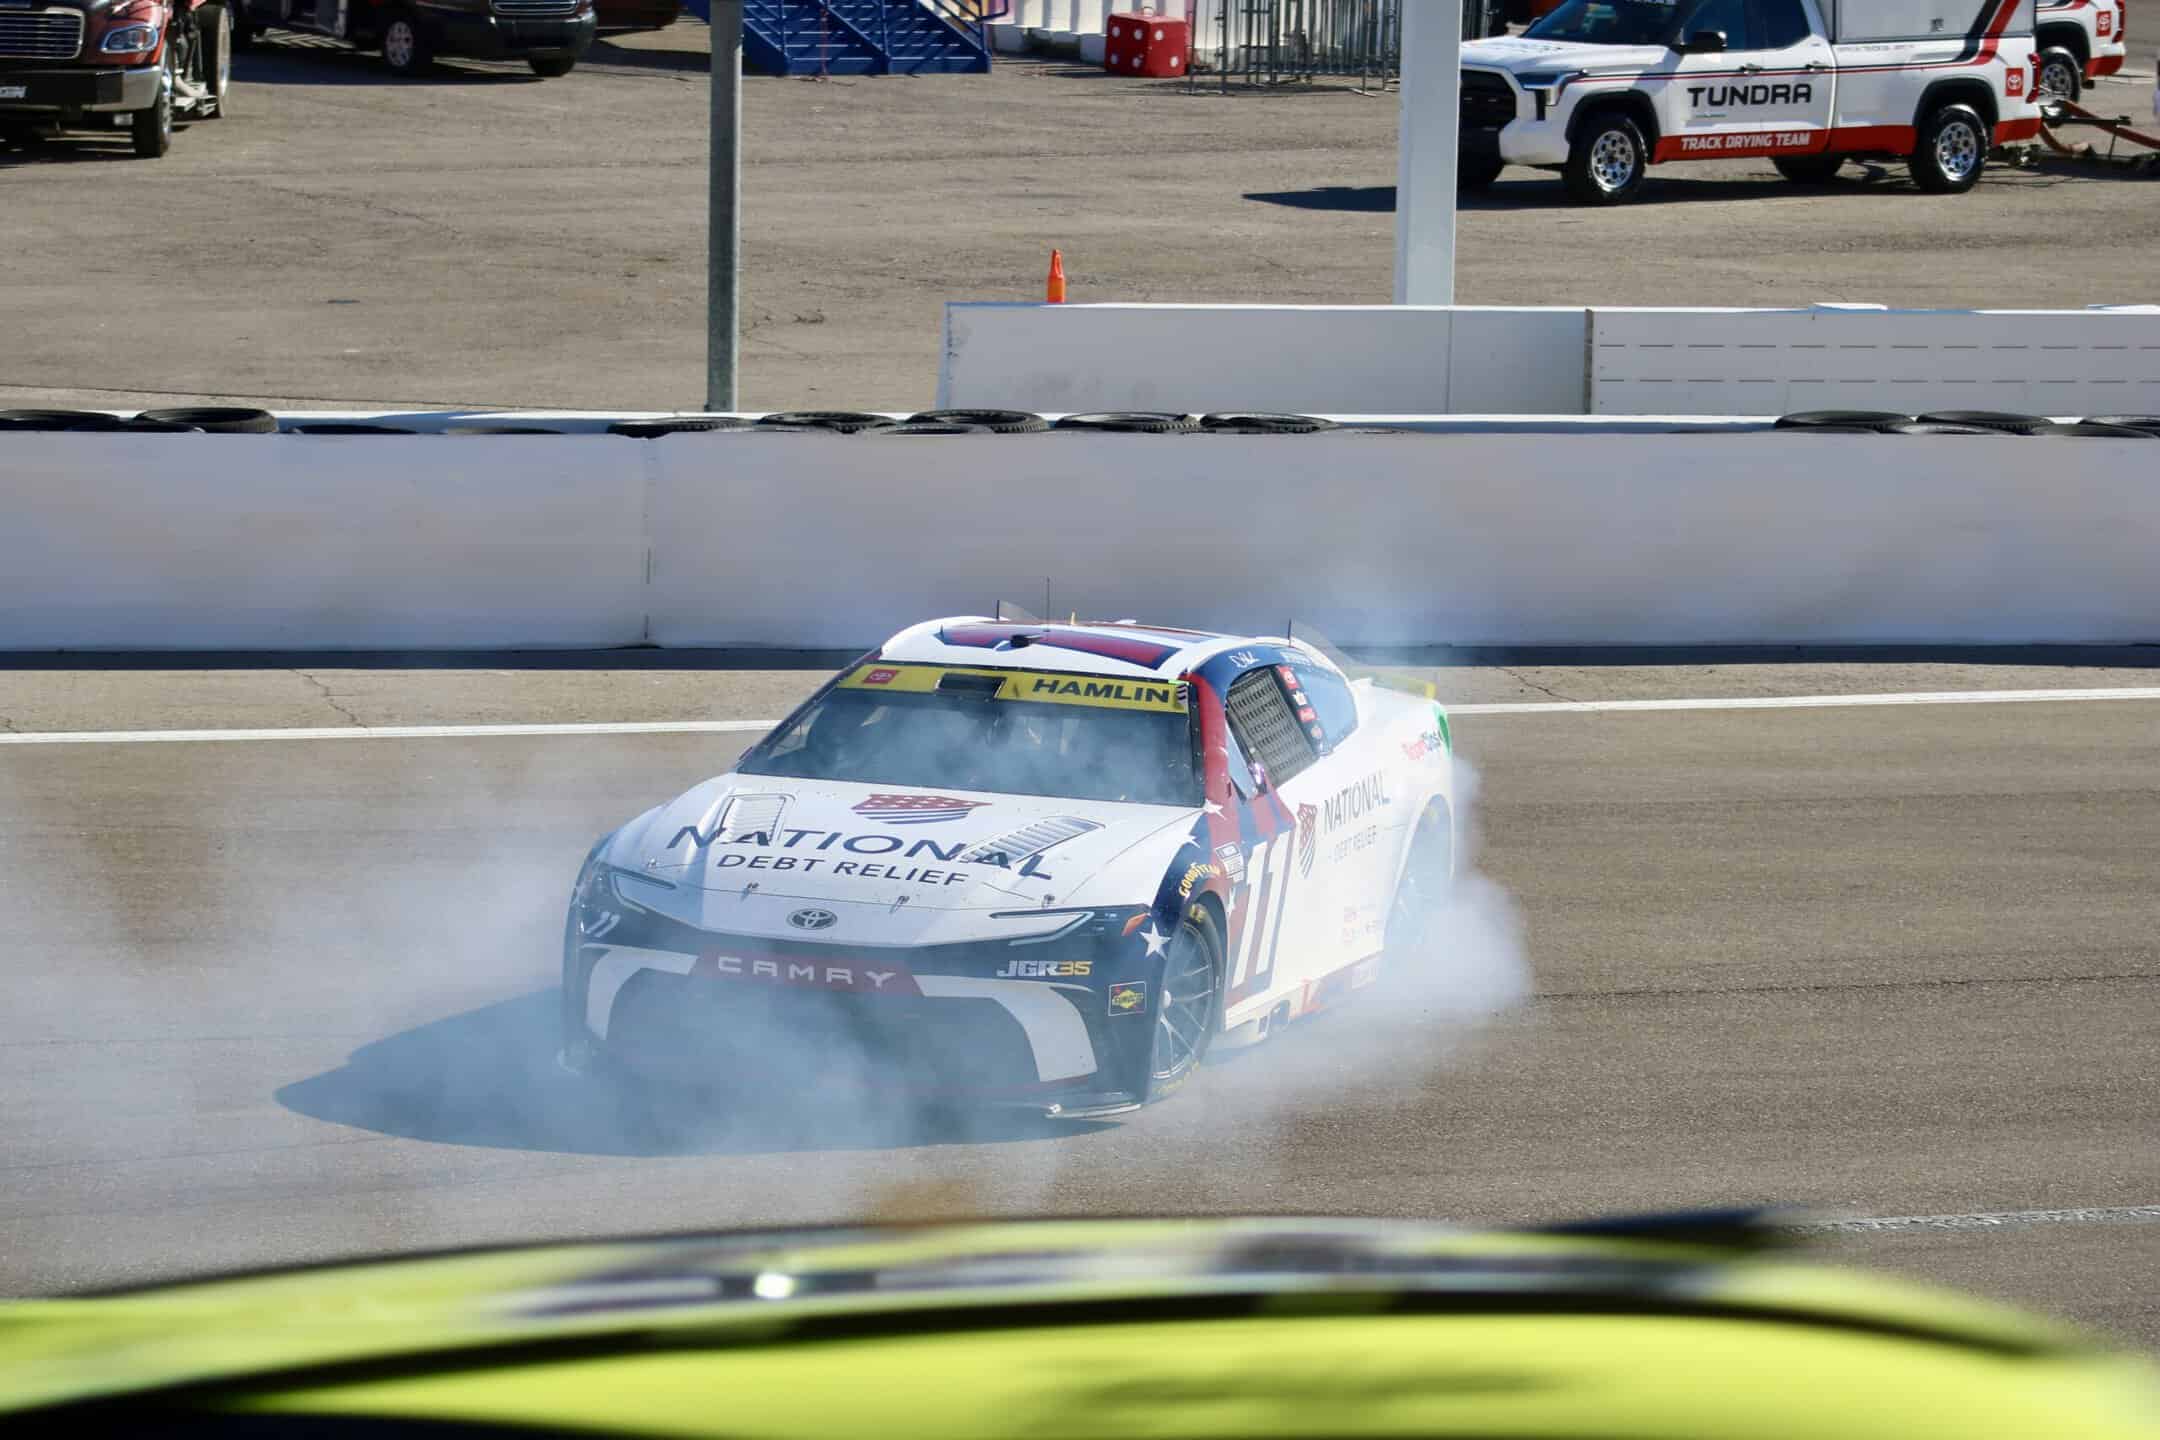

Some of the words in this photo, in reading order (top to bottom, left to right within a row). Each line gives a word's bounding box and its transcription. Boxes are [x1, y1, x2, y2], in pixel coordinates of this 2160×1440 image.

[1687, 84, 1812, 107] TUNDRA
[1681, 136, 1722, 150] TRACK
[1725, 134, 1772, 148] DRYING
[1775, 132, 1810, 146] TEAM
[1032, 679, 1169, 703] HAMLIN
[1324, 771, 1391, 835] NATIONAL
[667, 825, 1052, 880] NATIONAL
[717, 854, 825, 872] DEBT
[832, 861, 969, 886] RELIEF
[718, 956, 897, 988] CAMRY
[996, 960, 1094, 977] JGR35
